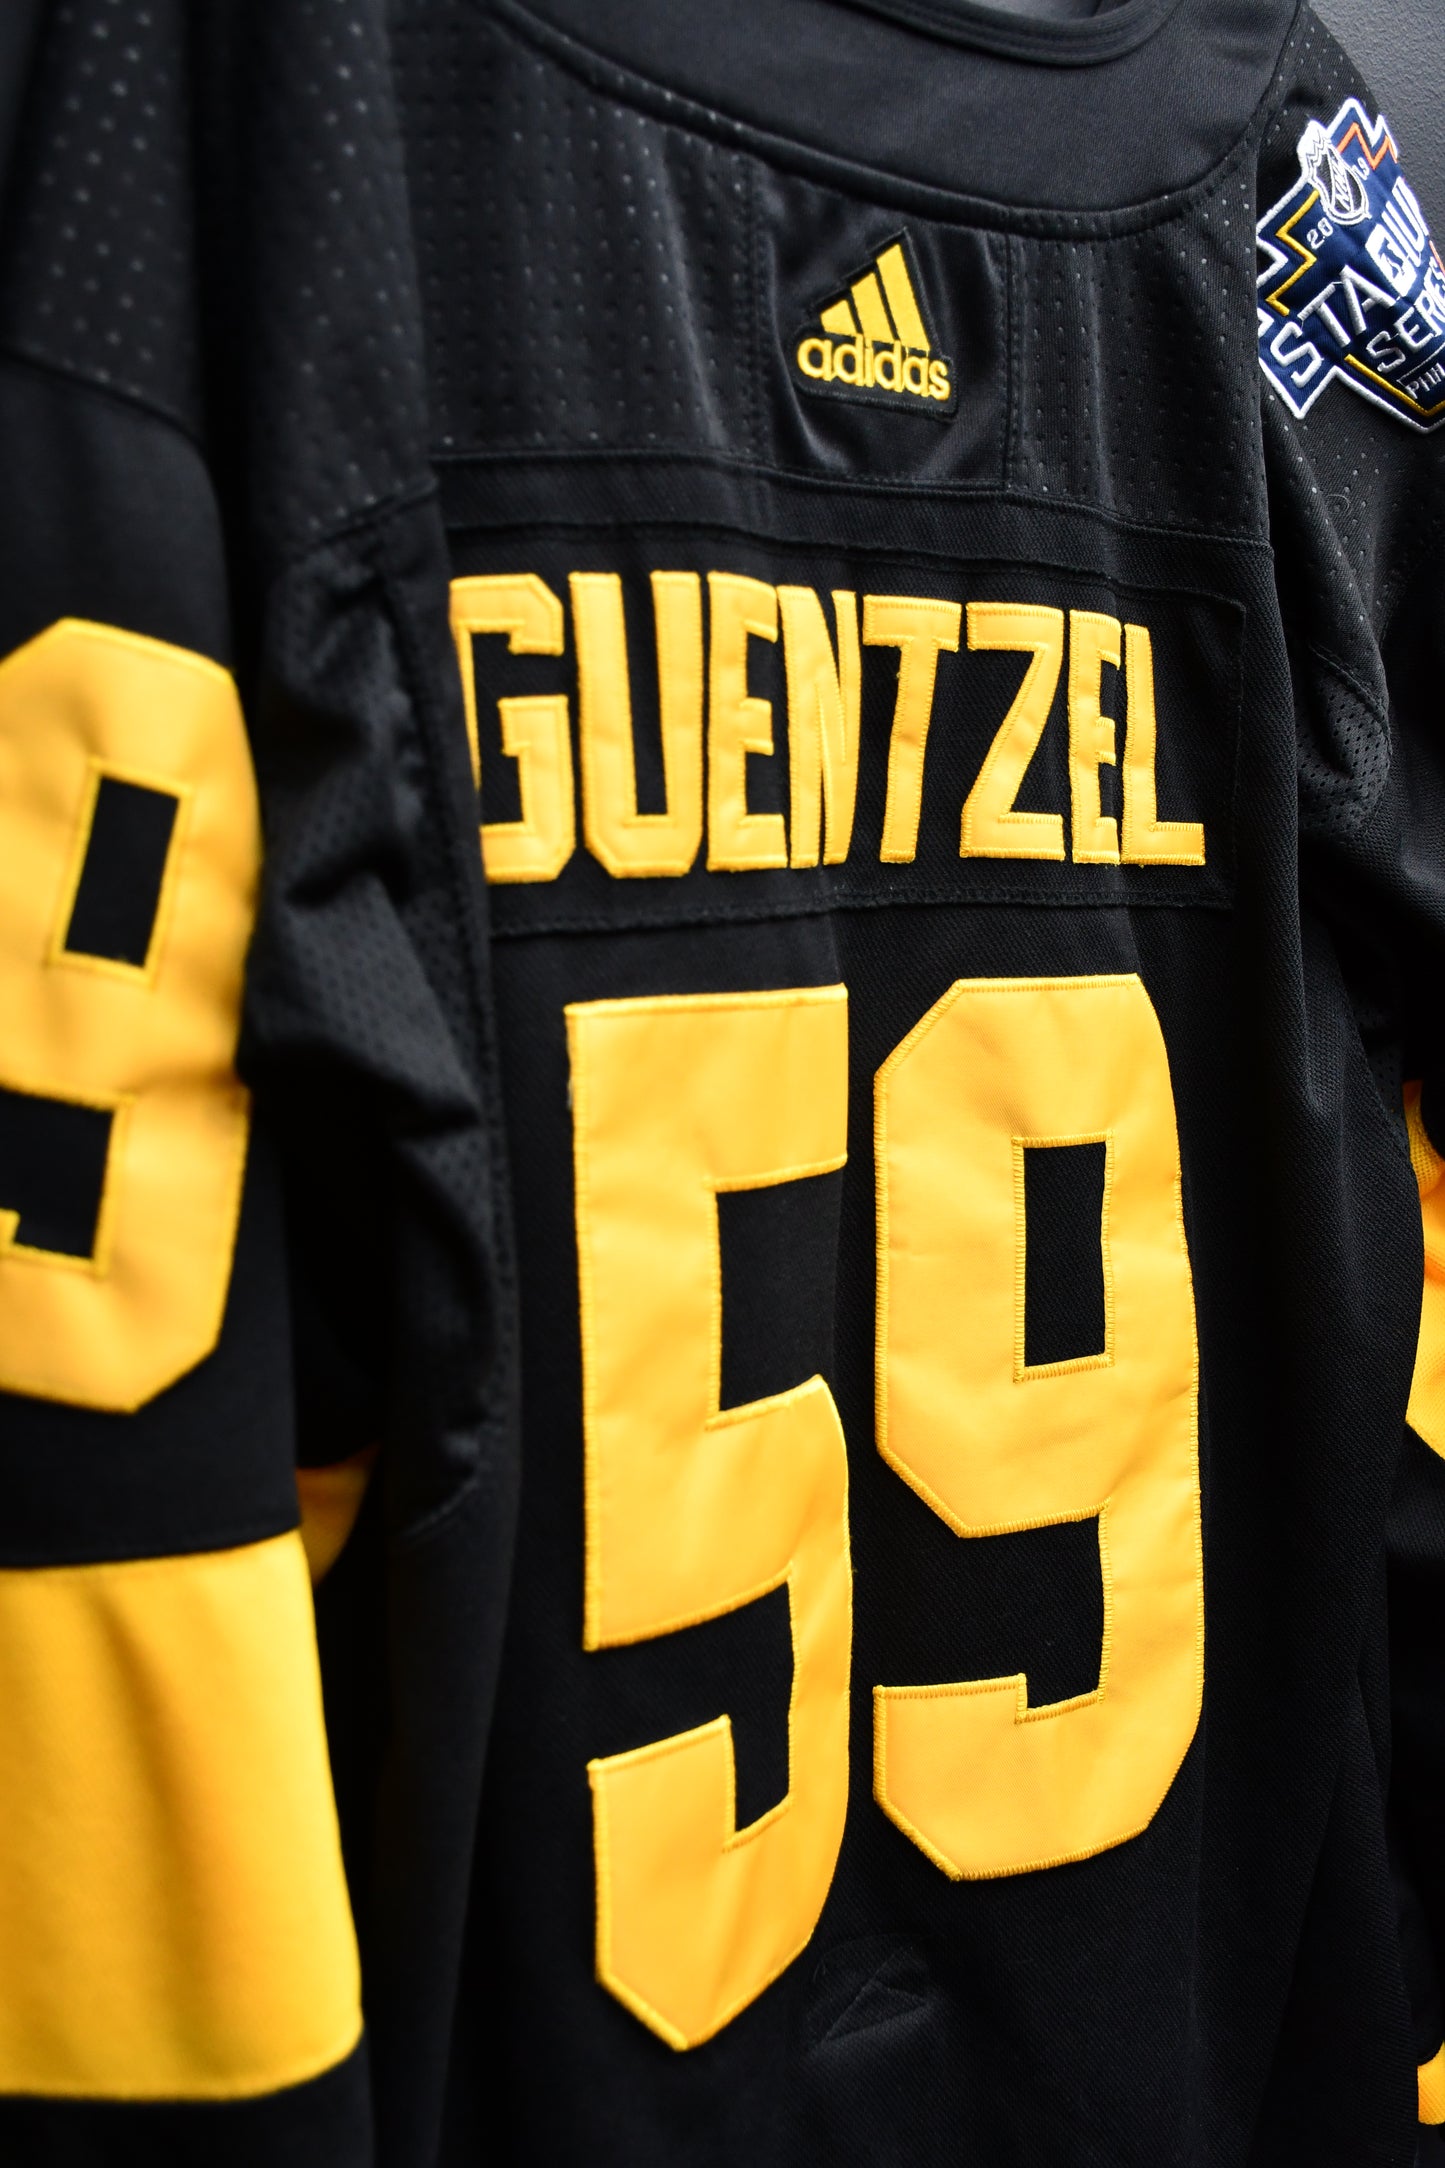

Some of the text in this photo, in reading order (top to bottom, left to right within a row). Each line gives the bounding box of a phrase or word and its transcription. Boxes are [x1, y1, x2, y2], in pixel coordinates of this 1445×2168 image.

[797, 332, 951, 401] adidas
[1307, 218, 1333, 249] 20
[449, 570, 1206, 884] GUENTZEL
[0, 618, 262, 1413] 9
[565, 973, 1205, 2051] 59
